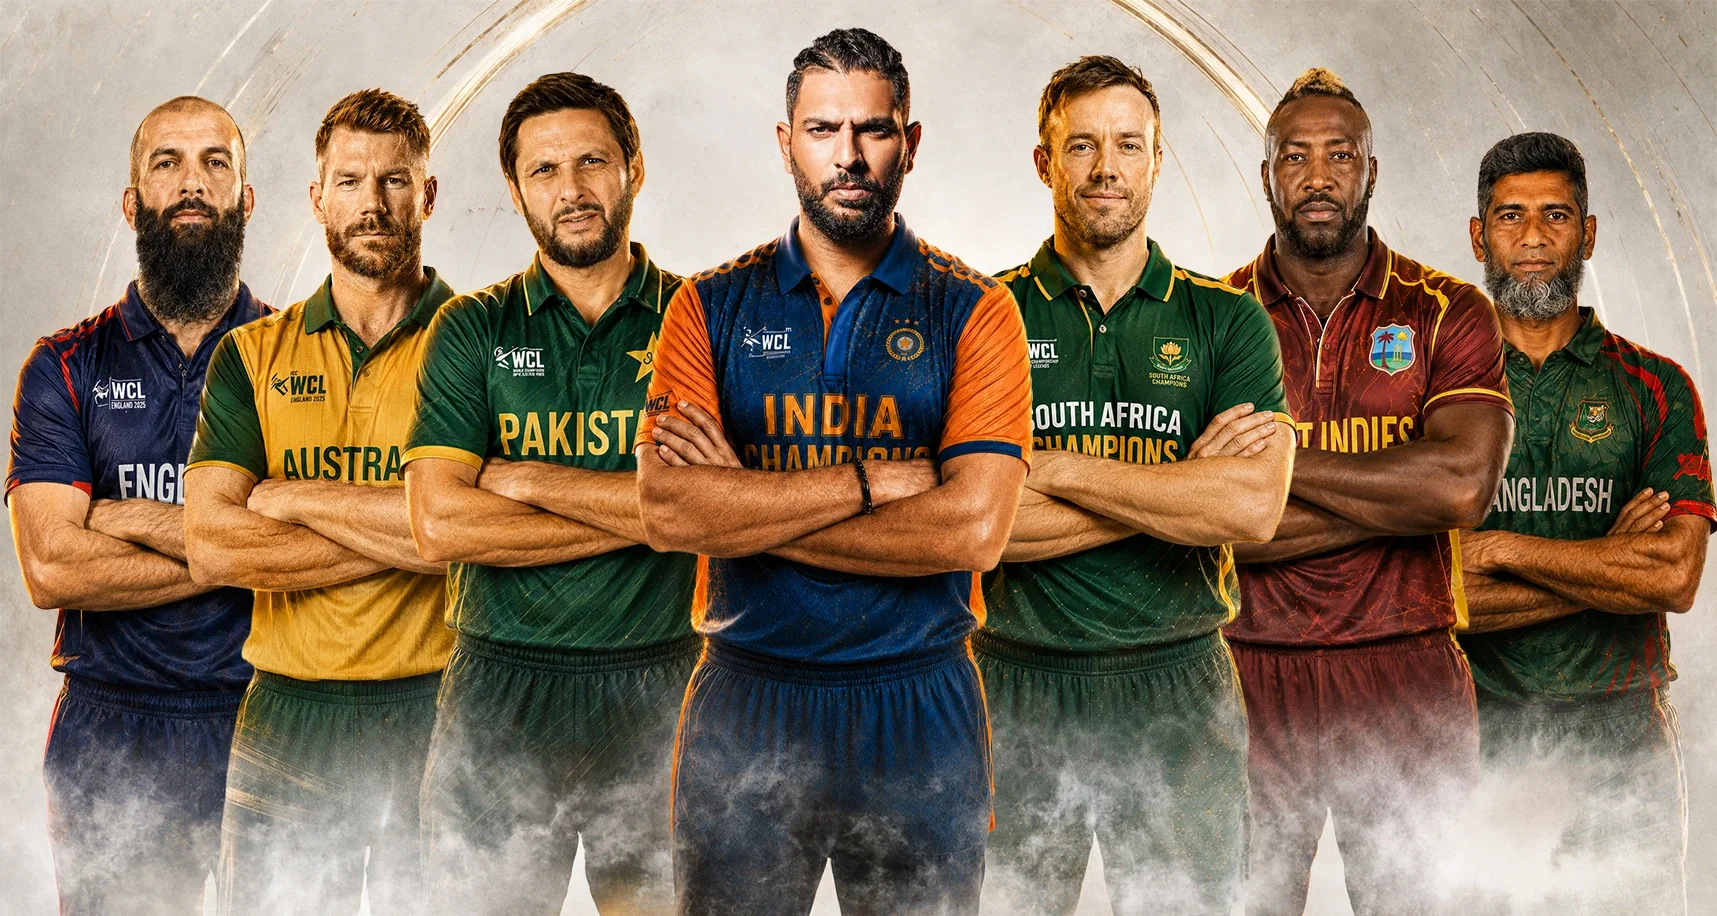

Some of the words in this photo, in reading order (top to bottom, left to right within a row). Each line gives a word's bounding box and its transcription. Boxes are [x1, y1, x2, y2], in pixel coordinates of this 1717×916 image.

[762, 334, 791, 350] WCL
[1027, 343, 1059, 359] WCL
[512, 350, 545, 368] WCL
[290, 375, 327, 396] WCL
[1149, 372, 1169, 380] SOUTH
[1170, 374, 1191, 382] AFRICA
[1152, 379, 1187, 388] CHAMPIONS
[111, 381, 146, 399] WCL
[111, 401, 133, 409] ENGLAND
[134, 401, 147, 409] 2025
[645, 396, 670, 412] WCL
[763, 393, 904, 439] INDIA
[1100, 402, 1181, 436] AFRICA
[1321, 416, 1413, 453] INDIES
[284, 445, 404, 481] AUSTRA
